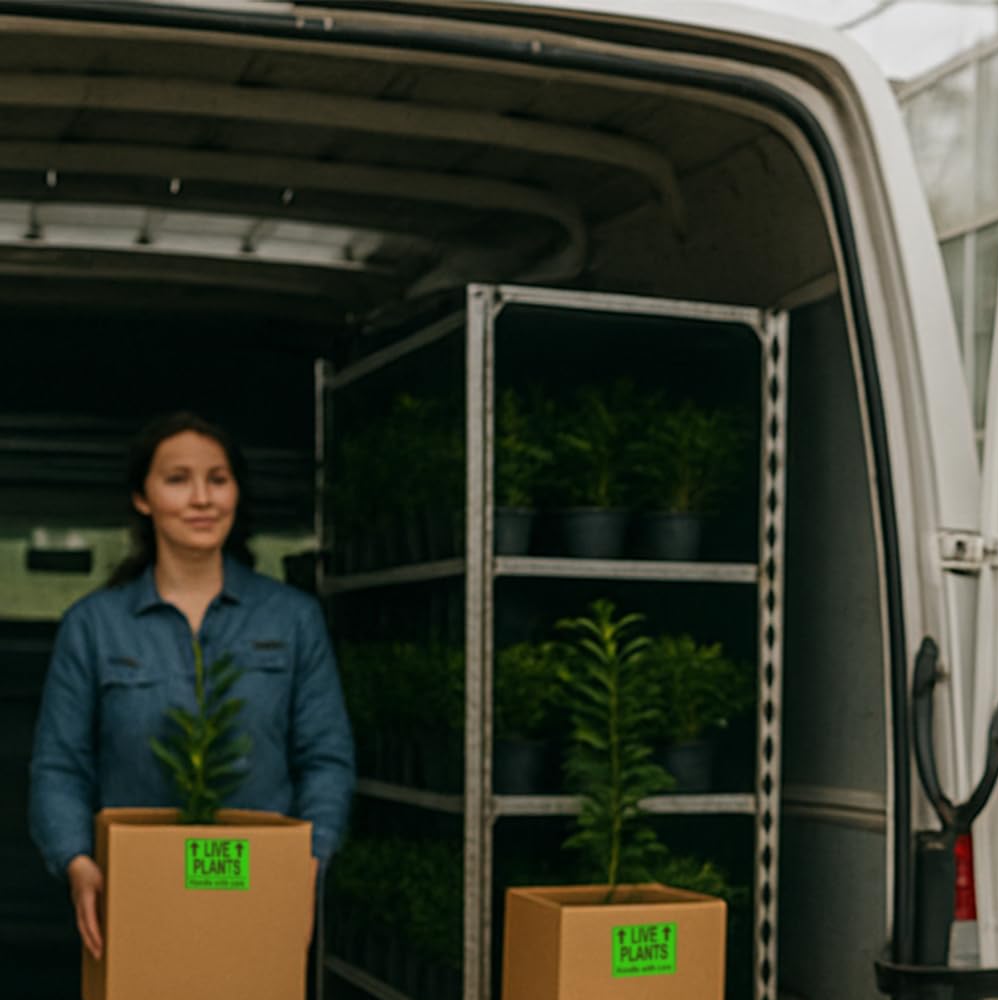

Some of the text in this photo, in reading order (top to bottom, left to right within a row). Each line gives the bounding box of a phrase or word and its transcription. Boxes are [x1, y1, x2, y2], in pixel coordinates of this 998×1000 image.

[204, 841, 231, 857] LIVE
[193, 859, 241, 875] PLANTS
[631, 925, 657, 944] LIVE
[620, 944, 668, 962] PLANTS
